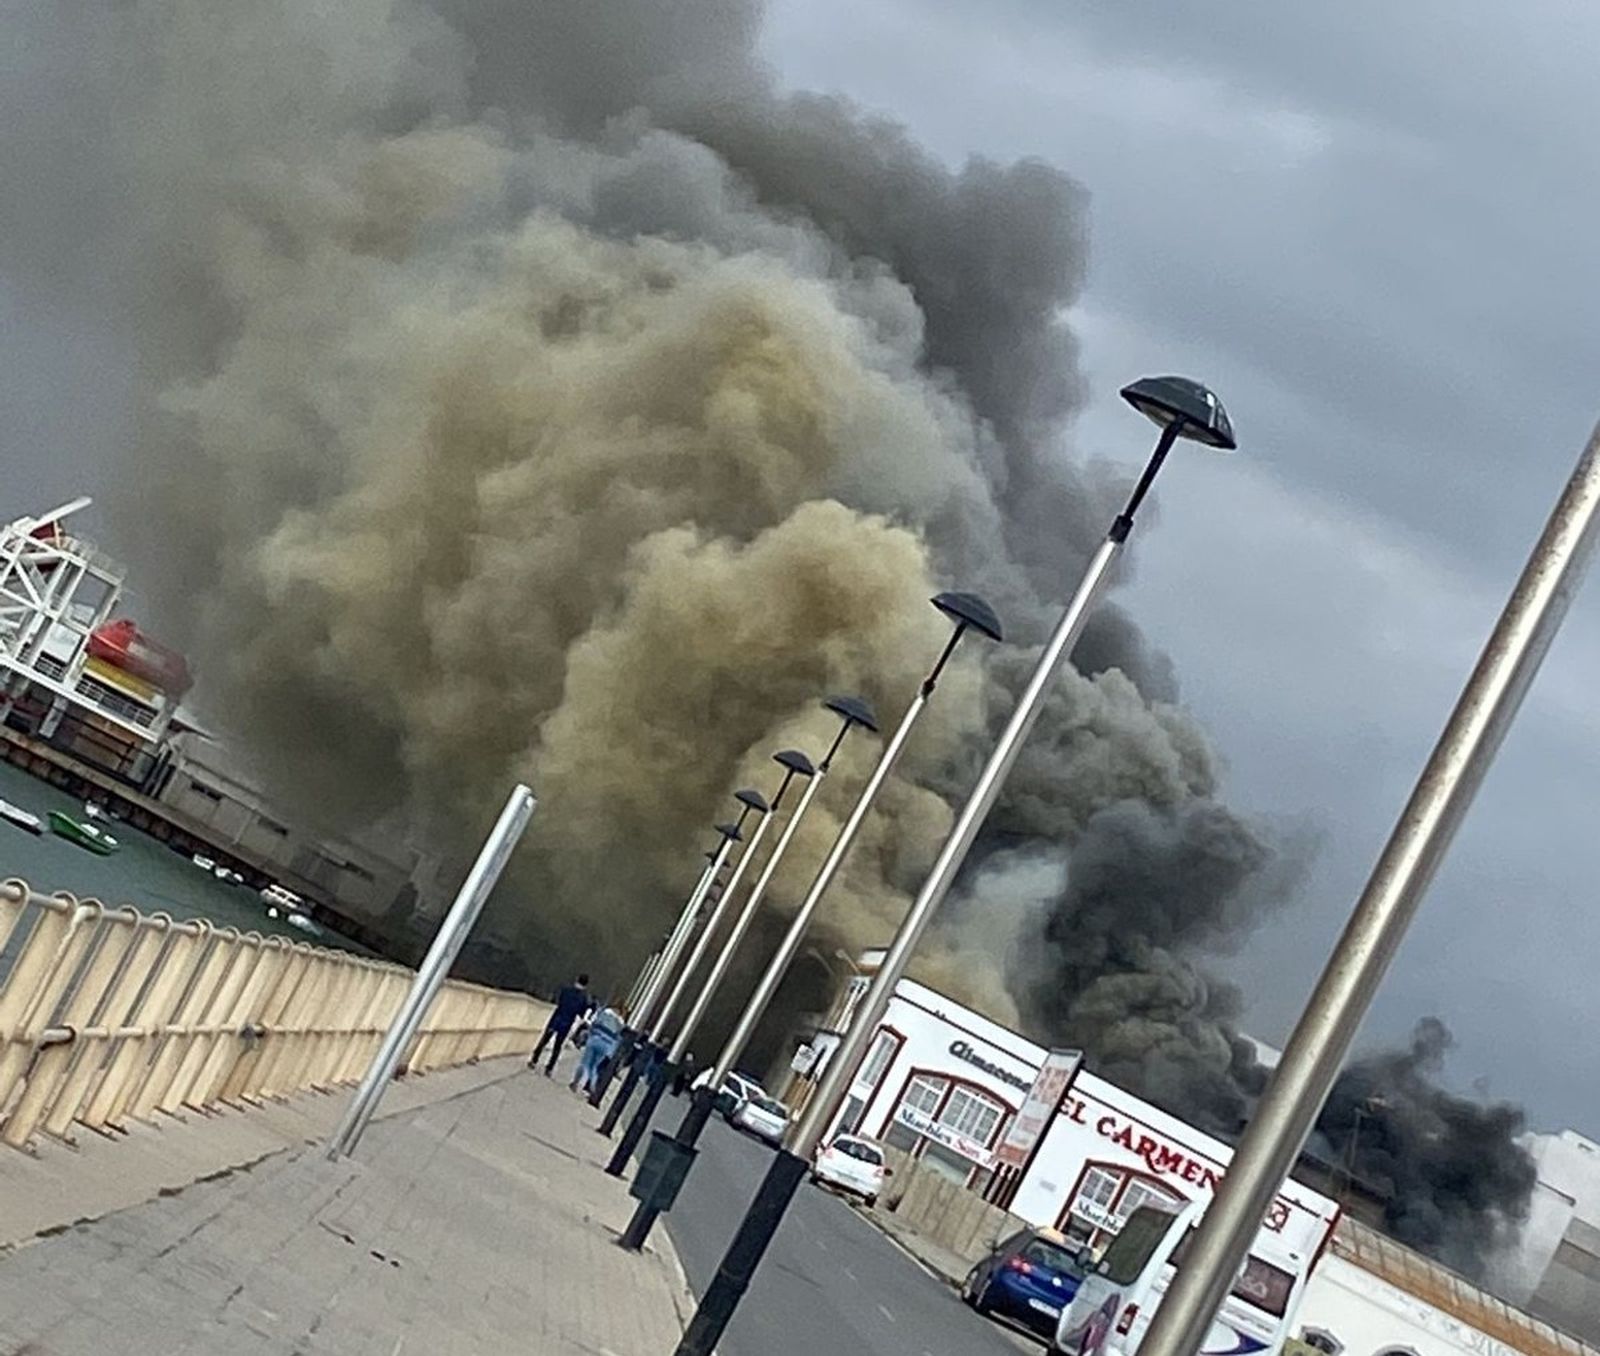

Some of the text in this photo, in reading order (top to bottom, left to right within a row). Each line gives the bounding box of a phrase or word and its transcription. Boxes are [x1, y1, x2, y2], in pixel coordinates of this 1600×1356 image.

[902, 1108, 952, 1145] Muebles
[1059, 1096, 1087, 1125] EL
[1096, 1116, 1222, 1189] CARMEN
